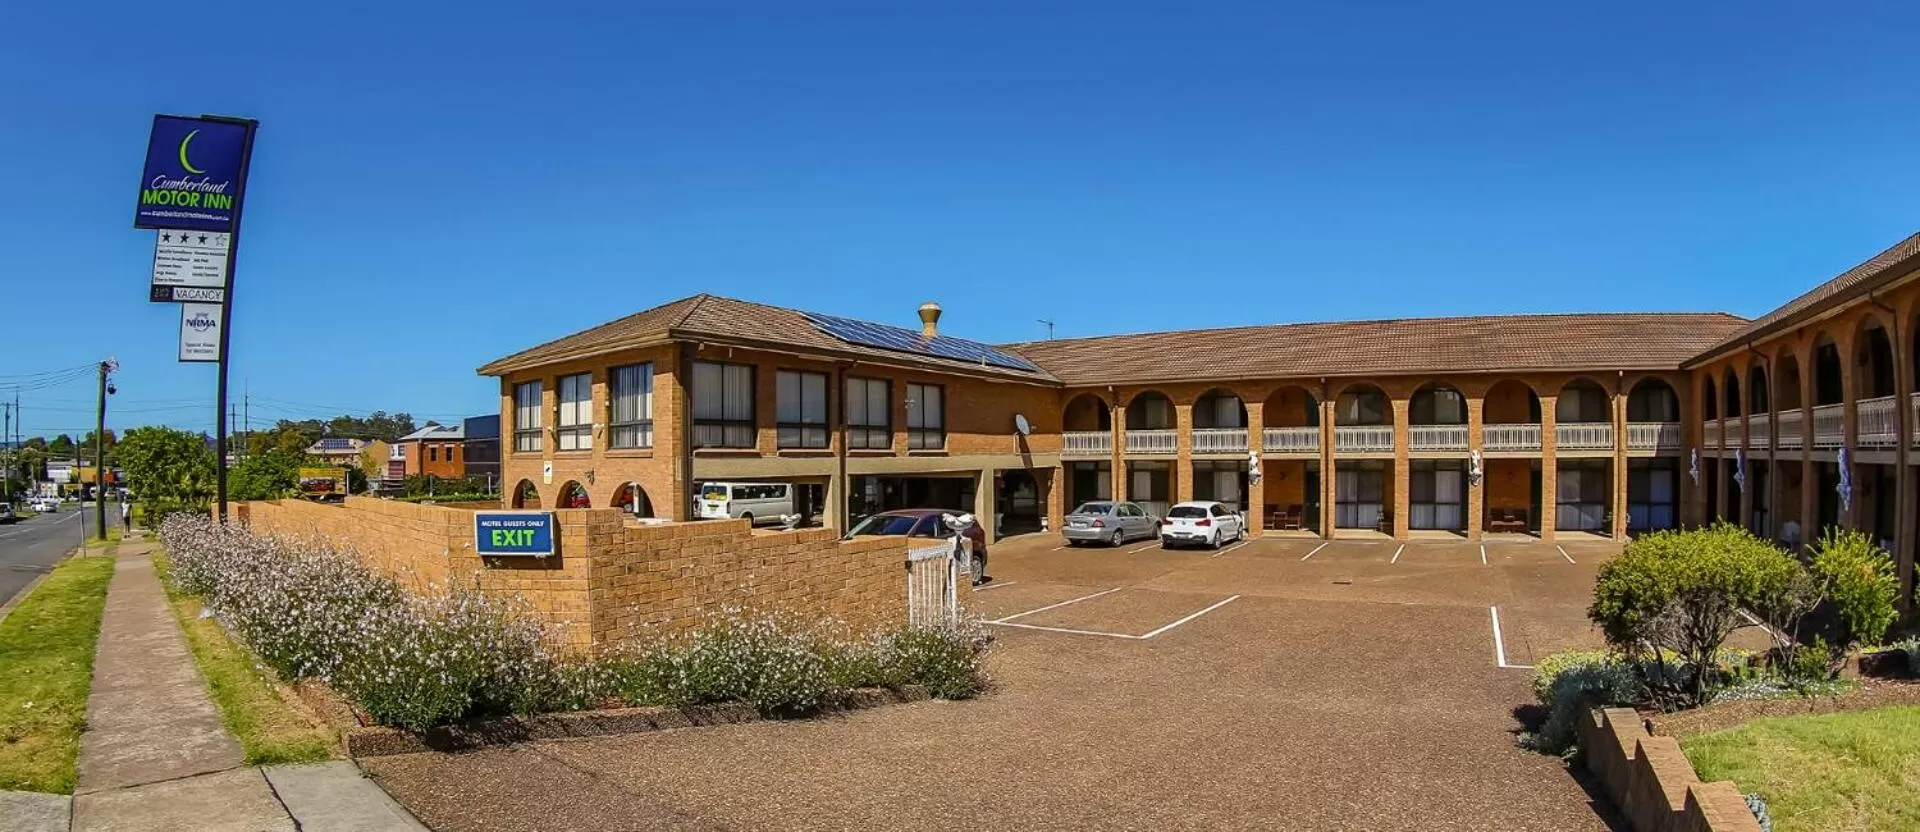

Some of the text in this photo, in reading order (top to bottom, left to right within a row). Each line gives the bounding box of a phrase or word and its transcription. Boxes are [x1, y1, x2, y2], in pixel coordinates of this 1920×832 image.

[151, 174, 229, 193] Cumberland
[143, 189, 232, 210] MOTOR INN
[175, 288, 221, 300] VACANCY
[186, 318, 216, 327] NRMA
[492, 529, 535, 546] EXIT
